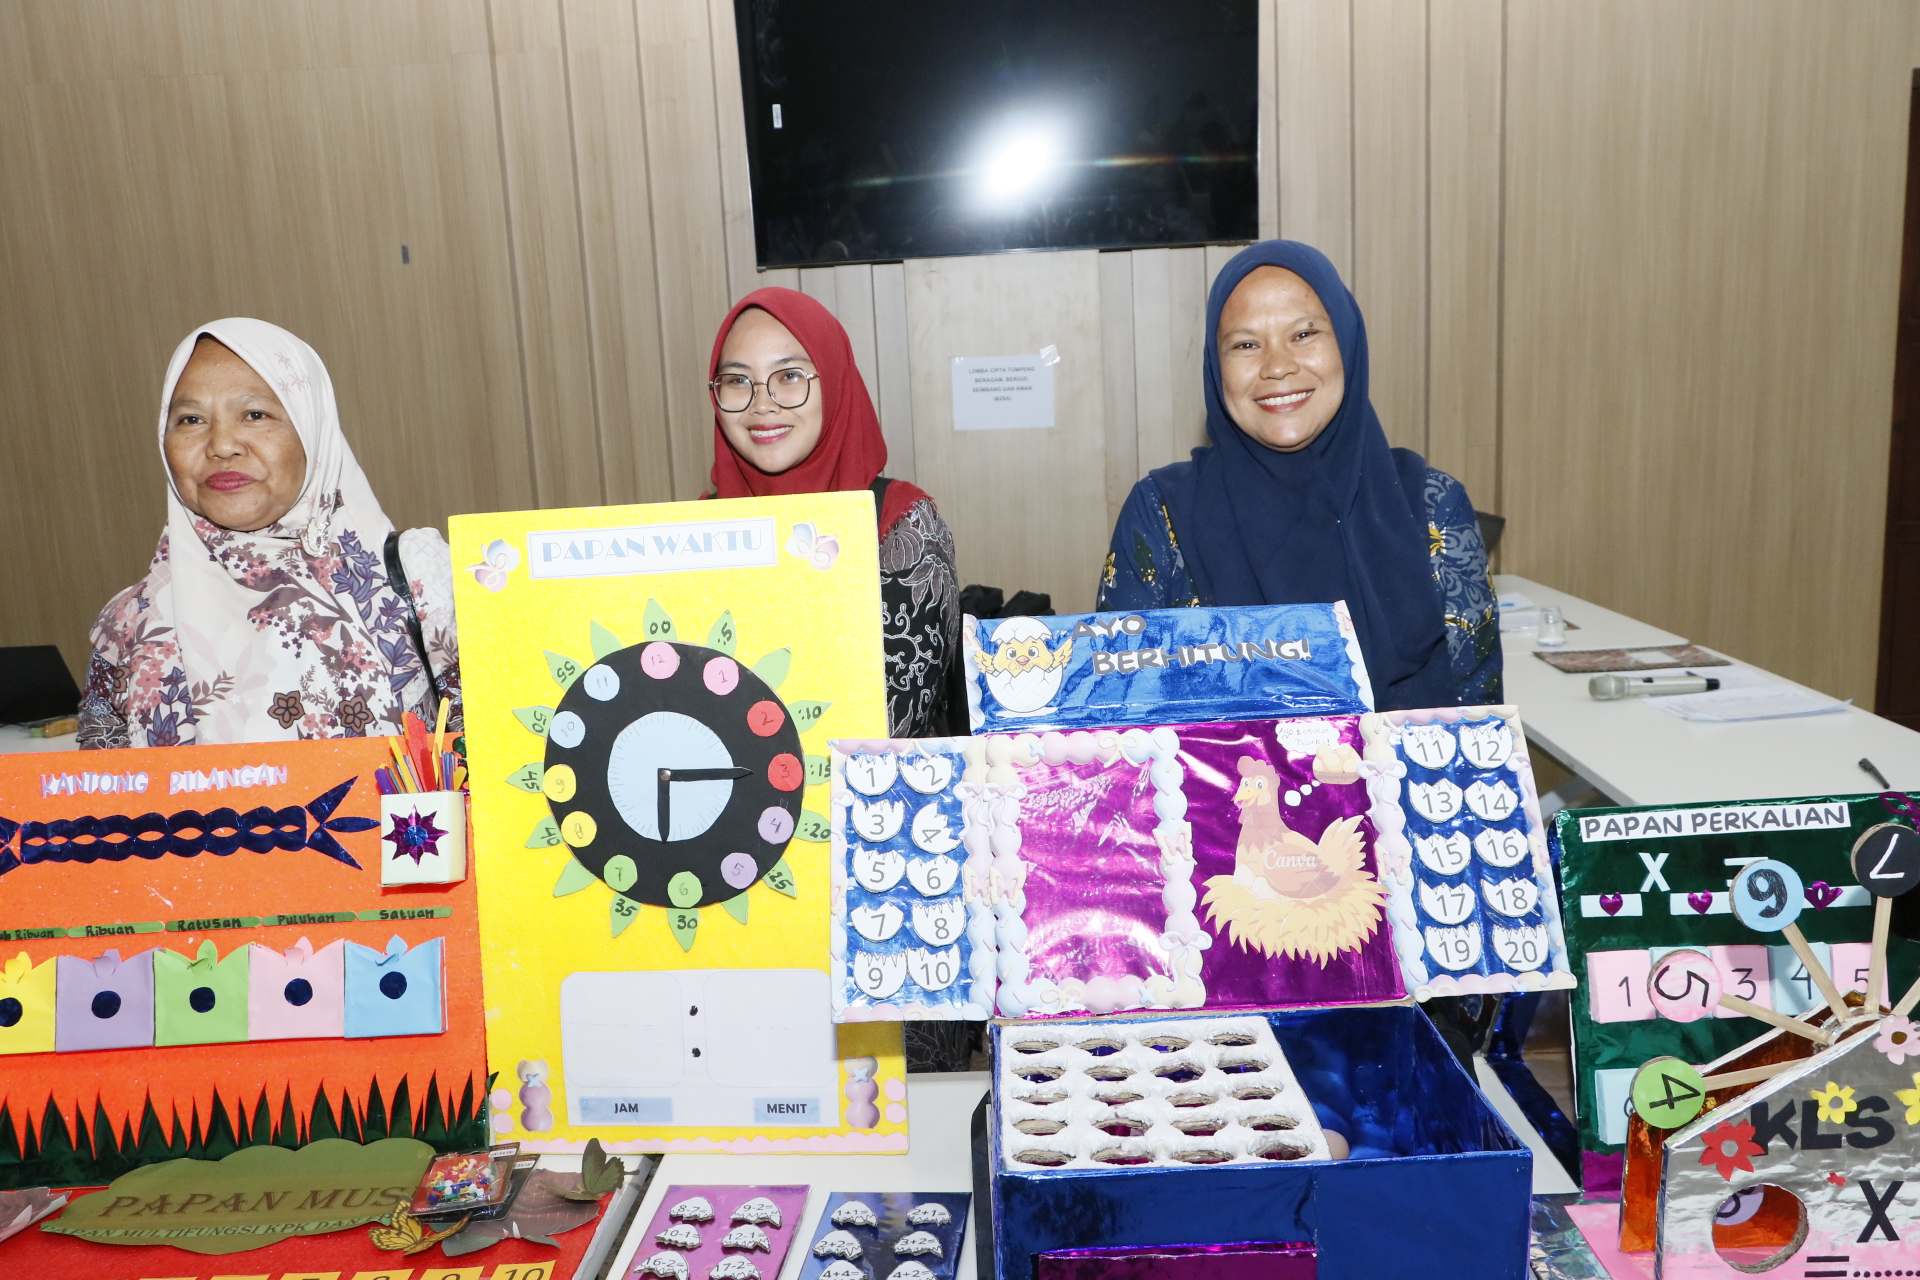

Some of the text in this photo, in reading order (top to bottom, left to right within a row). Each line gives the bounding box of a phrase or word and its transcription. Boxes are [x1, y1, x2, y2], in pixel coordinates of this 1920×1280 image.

[542, 529, 762, 562] PAPAN WAKTU
[1073, 615, 1146, 639] AYO
[651, 654, 665, 665] 12
[1092, 638, 1311, 676] BERHITUNG!
[556, 660, 576, 684] 55
[718, 670, 728, 684] 1
[761, 711, 774, 726] 2
[1417, 740, 1443, 762] 11
[1472, 739, 1502, 762] 12
[40, 763, 288, 798] KANTONG BILANGAN
[779, 763, 791, 779] 3
[866, 768, 876, 788] 1
[922, 765, 943, 786] 2
[1423, 791, 1452, 814] 13
[1477, 793, 1509, 815] 14
[770, 817, 782, 834] 4
[871, 814, 885, 836] 3
[1584, 805, 1846, 839] PAPAN PERKALIAN
[922, 827, 941, 844] 4
[1432, 843, 1464, 868] 15
[1487, 836, 1519, 860] 16
[731, 863, 744, 877] 5
[1264, 850, 1318, 870] Canva
[871, 861, 885, 884] 5
[927, 868, 941, 890] 6
[678, 882, 689, 896] 6
[1495, 887, 1528, 911] 18
[379, 908, 435, 920] Satuan
[614, 898, 638, 917] 35
[1436, 893, 1467, 918] 17
[178, 917, 242, 932] Ratusan
[277, 913, 335, 926] Puluhan
[677, 914, 698, 930] 30
[871, 913, 886, 938] 7
[935, 918, 949, 940] 8
[85, 924, 135, 938] Ribuan
[1440, 938, 1470, 964] 19
[1504, 941, 1539, 964] 20
[868, 967, 883, 990] 9
[919, 962, 950, 985] 10
[1732, 968, 1757, 1001] 3
[1791, 963, 1813, 1000] 4
[1617, 976, 1632, 1007] 1
[614, 1102, 640, 1114] JAM
[766, 1102, 808, 1115] MENIT
[1749, 1095, 1896, 1157] KLS
[98, 1186, 418, 1218] PAPAN MUS
[678, 1204, 708, 1214] 8-7=
[743, 1203, 774, 1212] 9-2=
[837, 1209, 868, 1217] 1+1=
[912, 1208, 946, 1217] 2+1=
[37, 1225, 115, 1237] PAPAN
[120, 1225, 260, 1238] MULTIFUNGSI
[263, 1223, 306, 1235] KPK
[728, 1231, 766, 1240] 12-1=
[819, 1240, 855, 1248] 2+2=
[899, 1238, 935, 1246] 3+2=
